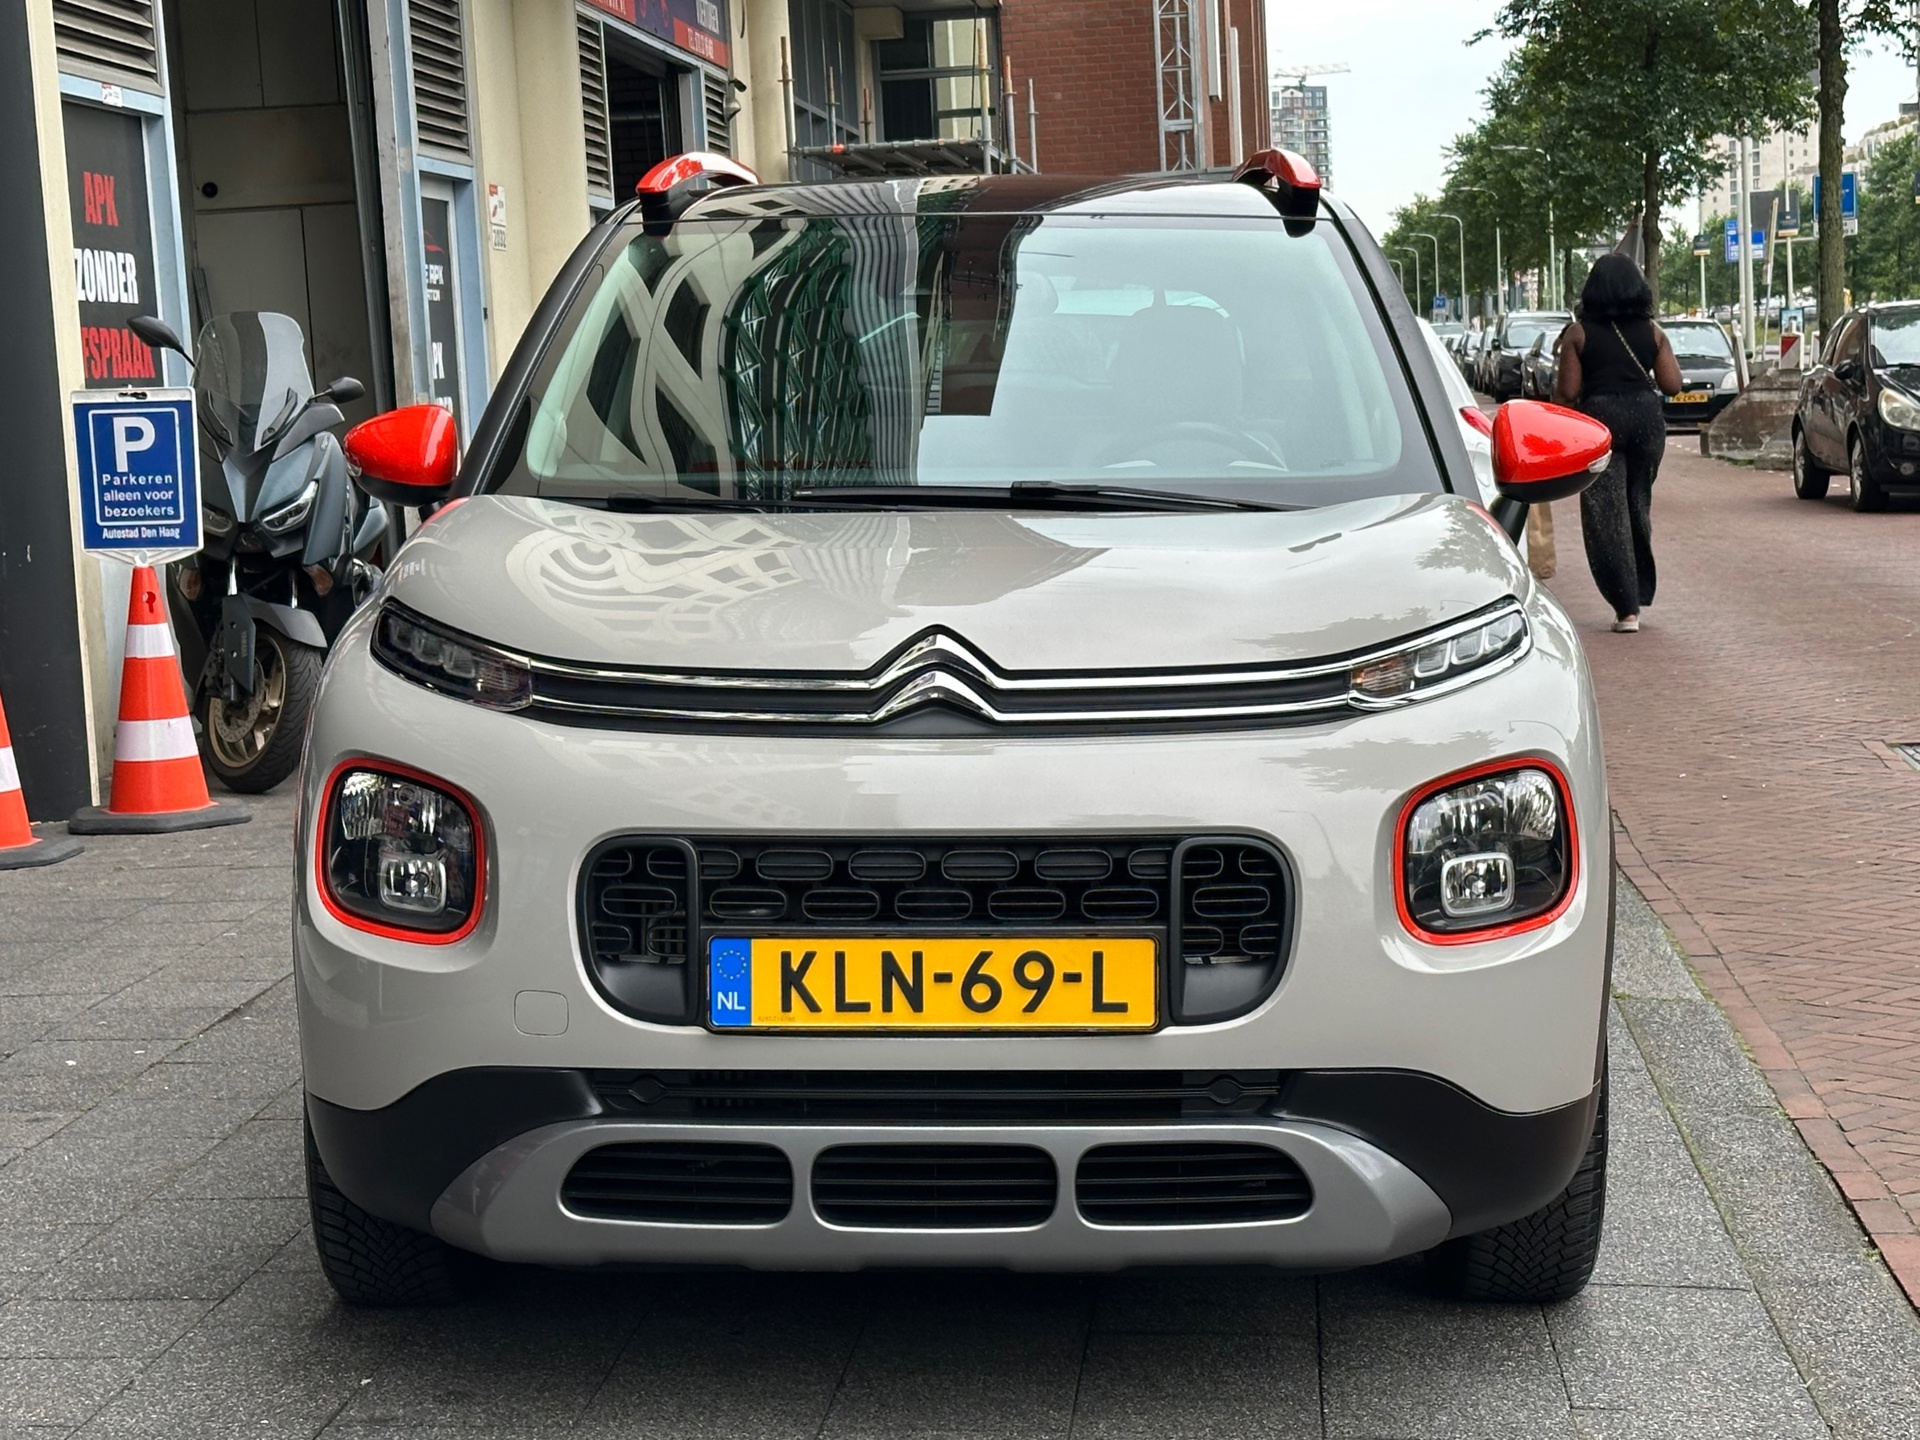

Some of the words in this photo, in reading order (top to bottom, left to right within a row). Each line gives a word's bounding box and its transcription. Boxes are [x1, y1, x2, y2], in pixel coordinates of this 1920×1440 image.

[83, 171, 119, 227] APK
[73, 248, 139, 305] ZONDER
[81, 327, 156, 380] FSPRAAK
[113, 416, 156, 473] P
[102, 473, 173, 486] Parkeren
[103, 490, 141, 502] alleen
[145, 490, 174, 501] voor
[104, 505, 175, 518] bezoekers
[102, 527, 139, 539] Autostad
[141, 527, 158, 538] Den
[159, 527, 180, 539] Haag
[780, 949, 1129, 1014] KLN-69-L
[716, 991, 746, 1011] NL
